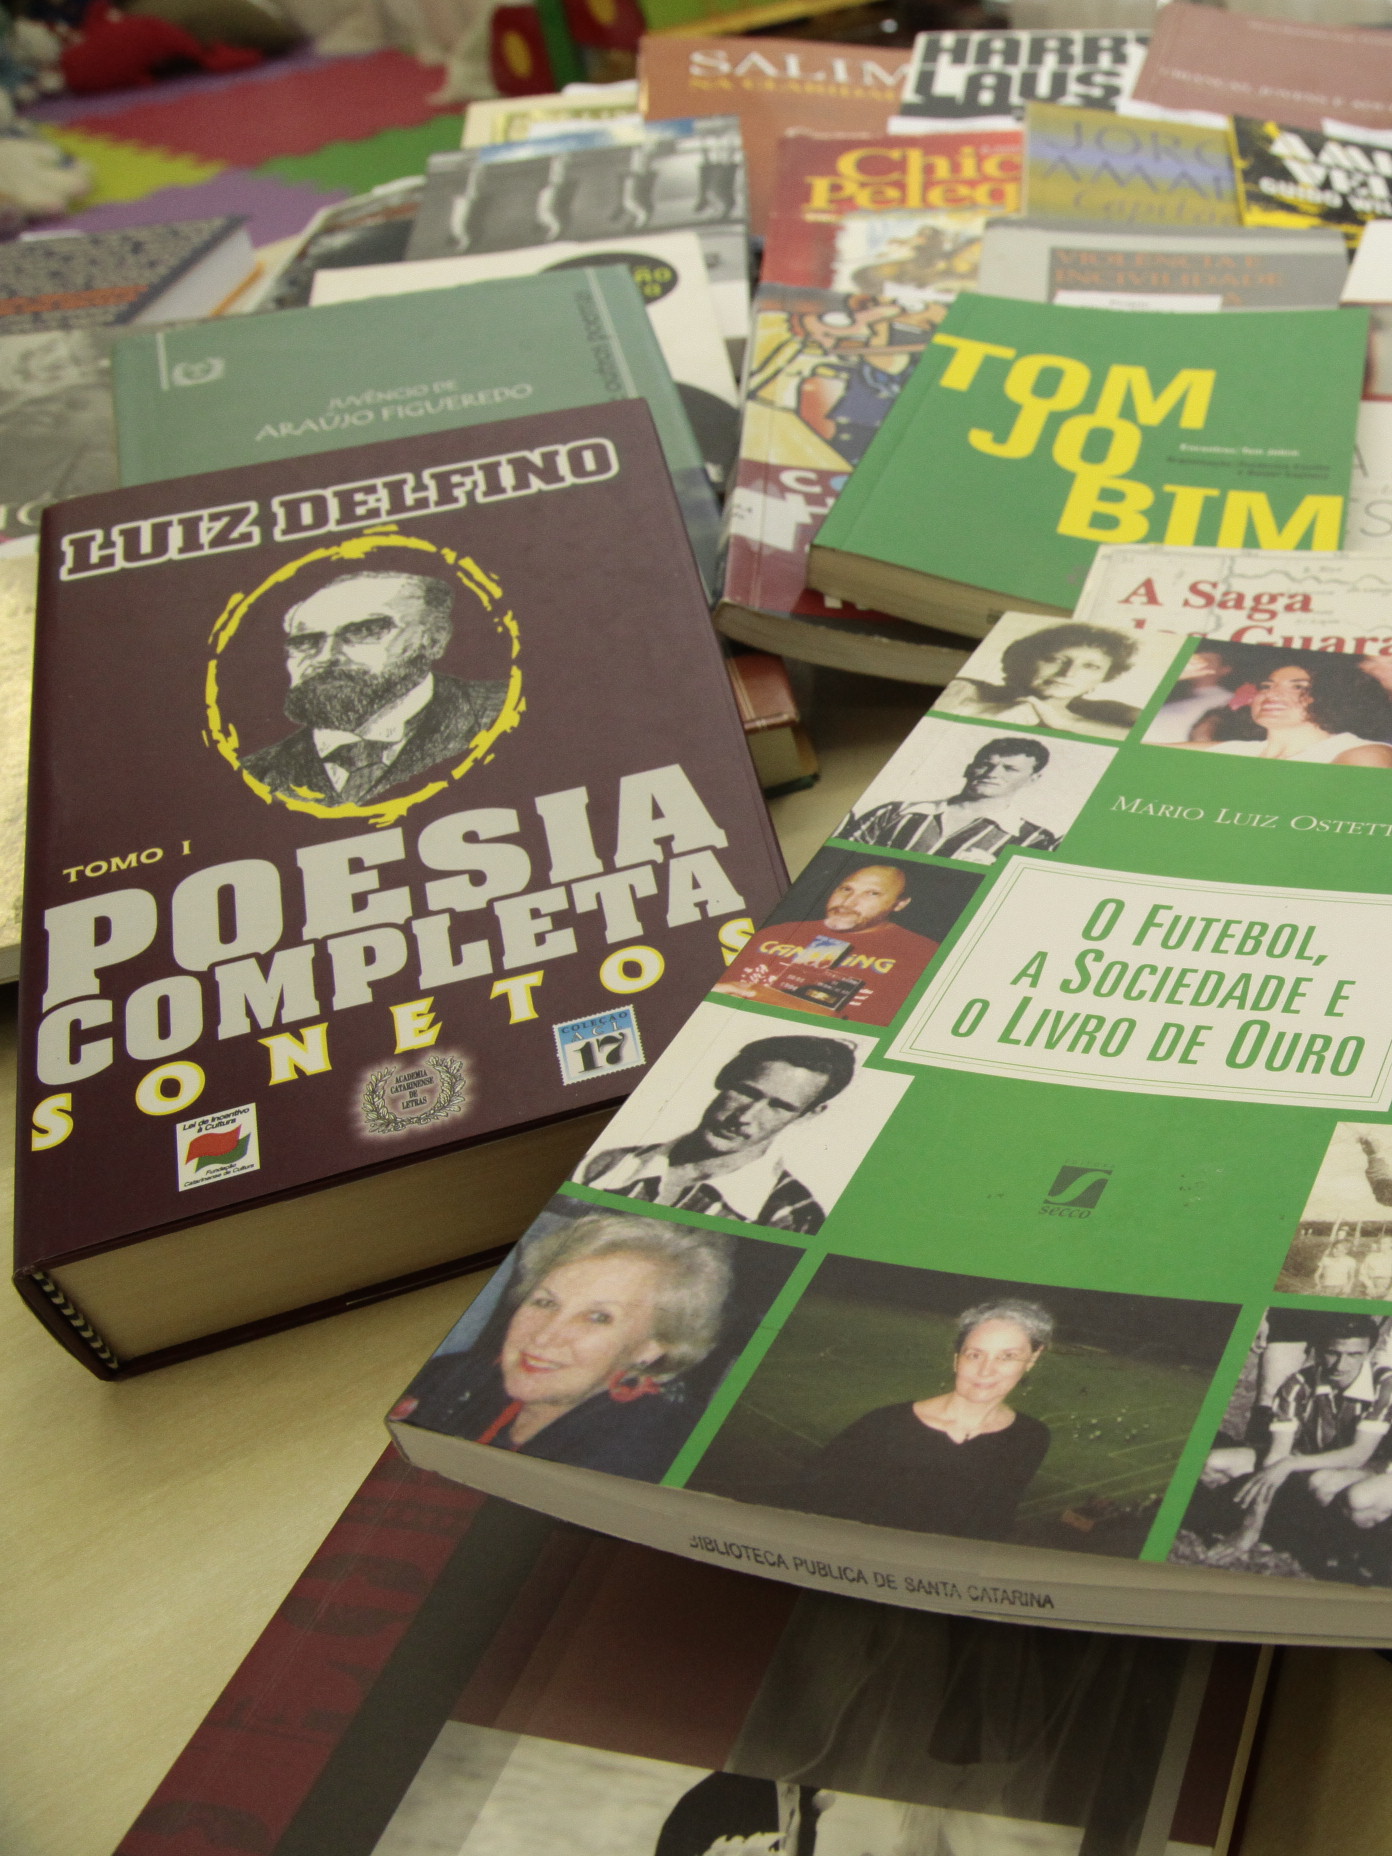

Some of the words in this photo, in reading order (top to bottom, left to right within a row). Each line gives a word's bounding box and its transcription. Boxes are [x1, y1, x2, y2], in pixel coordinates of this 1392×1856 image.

[922, 36, 1151, 66] HARR
[931, 332, 1217, 431] TOM
[968, 400, 1142, 478] JO
[60, 502, 258, 580] LUIZ
[272, 438, 620, 541] DELFINO
[1056, 471, 1346, 551] BIM
[1116, 576, 1164, 606] A
[1182, 579, 1313, 623] Saga
[1213, 805, 1279, 831] LUIZ
[63, 846, 164, 883] TOMO
[181, 839, 192, 857] I
[42, 763, 729, 1011] POESIA
[1081, 897, 1126, 942] O
[1132, 903, 1329, 966] FUTEBOL,
[36, 849, 747, 1085] COMPLETA
[1010, 950, 1048, 989] A
[1060, 947, 1308, 1016] SOCIEDADE
[1323, 979, 1356, 1018] E
[561, 1011, 628, 1034] COLEÇÃO
[950, 997, 991, 1039] O
[997, 995, 1138, 1060] LIVRO
[1146, 1023, 1215, 1066] DE
[1225, 1018, 1367, 1077] OURO
[573, 1031, 626, 1074] 17
[395, 1069, 428, 1084] ACADEMIA
[409, 1090, 418, 1099] DE
[182, 1121, 197, 1131] Lei
[198, 1119, 210, 1128] de
[211, 1107, 250, 1123] Incentivo
[205, 1118, 237, 1132] Cultura
[401, 1096, 428, 1110] LETRAS
[873, 1571, 898, 1591] DE
[904, 1576, 962, 1601] SANTA
[967, 1584, 1055, 1610] CATARINA
